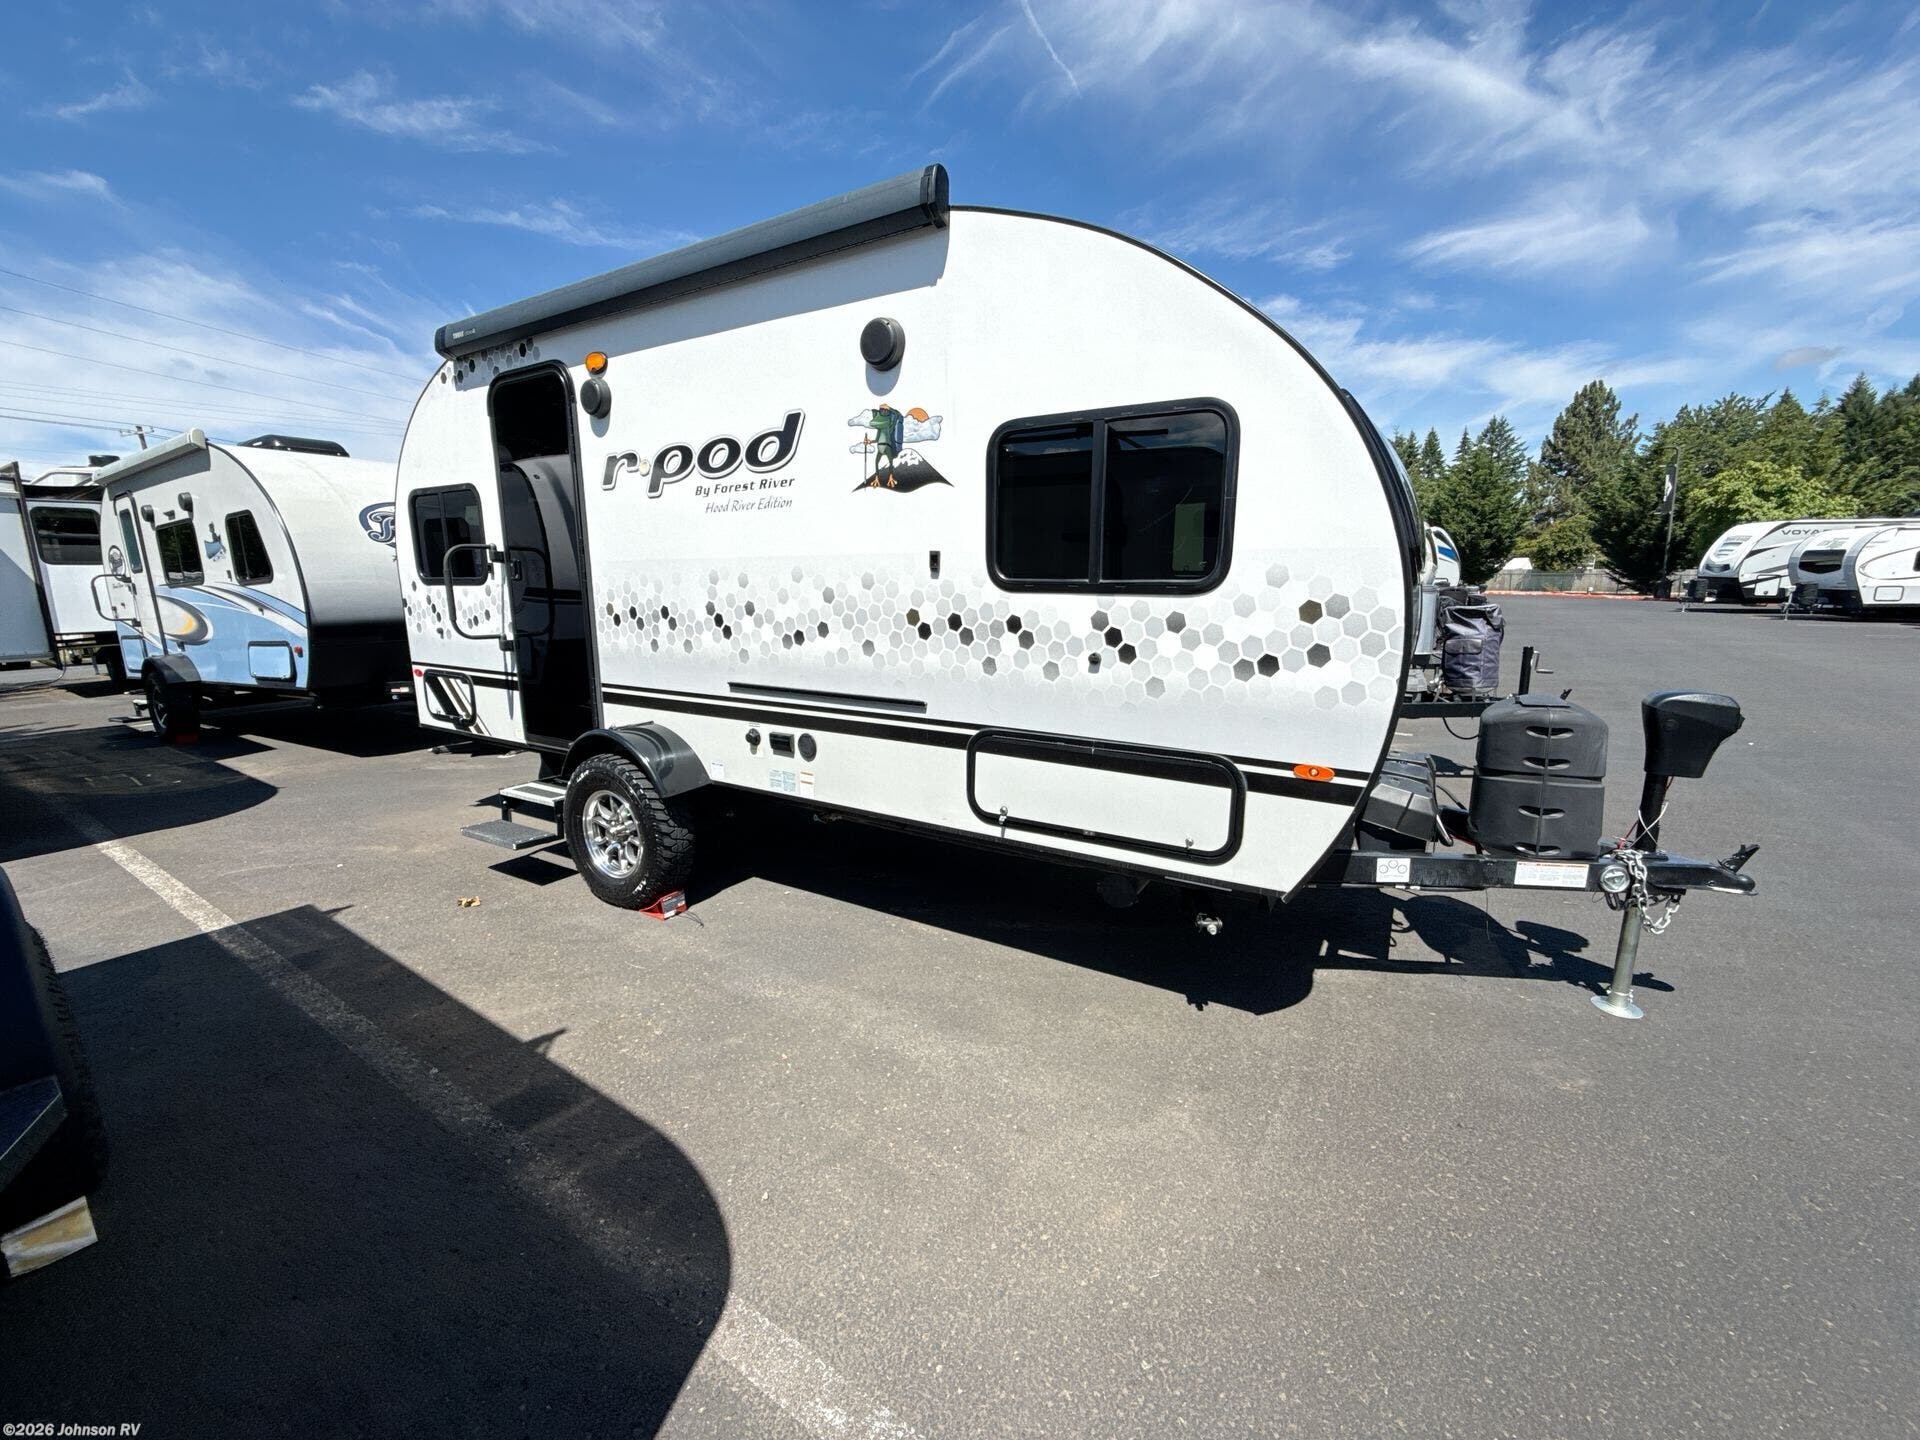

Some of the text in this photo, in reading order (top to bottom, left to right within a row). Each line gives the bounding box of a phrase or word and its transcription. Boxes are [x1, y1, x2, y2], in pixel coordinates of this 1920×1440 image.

[695, 478, 795, 498] By Forest River
[705, 495, 793, 513] Hood River Edition
